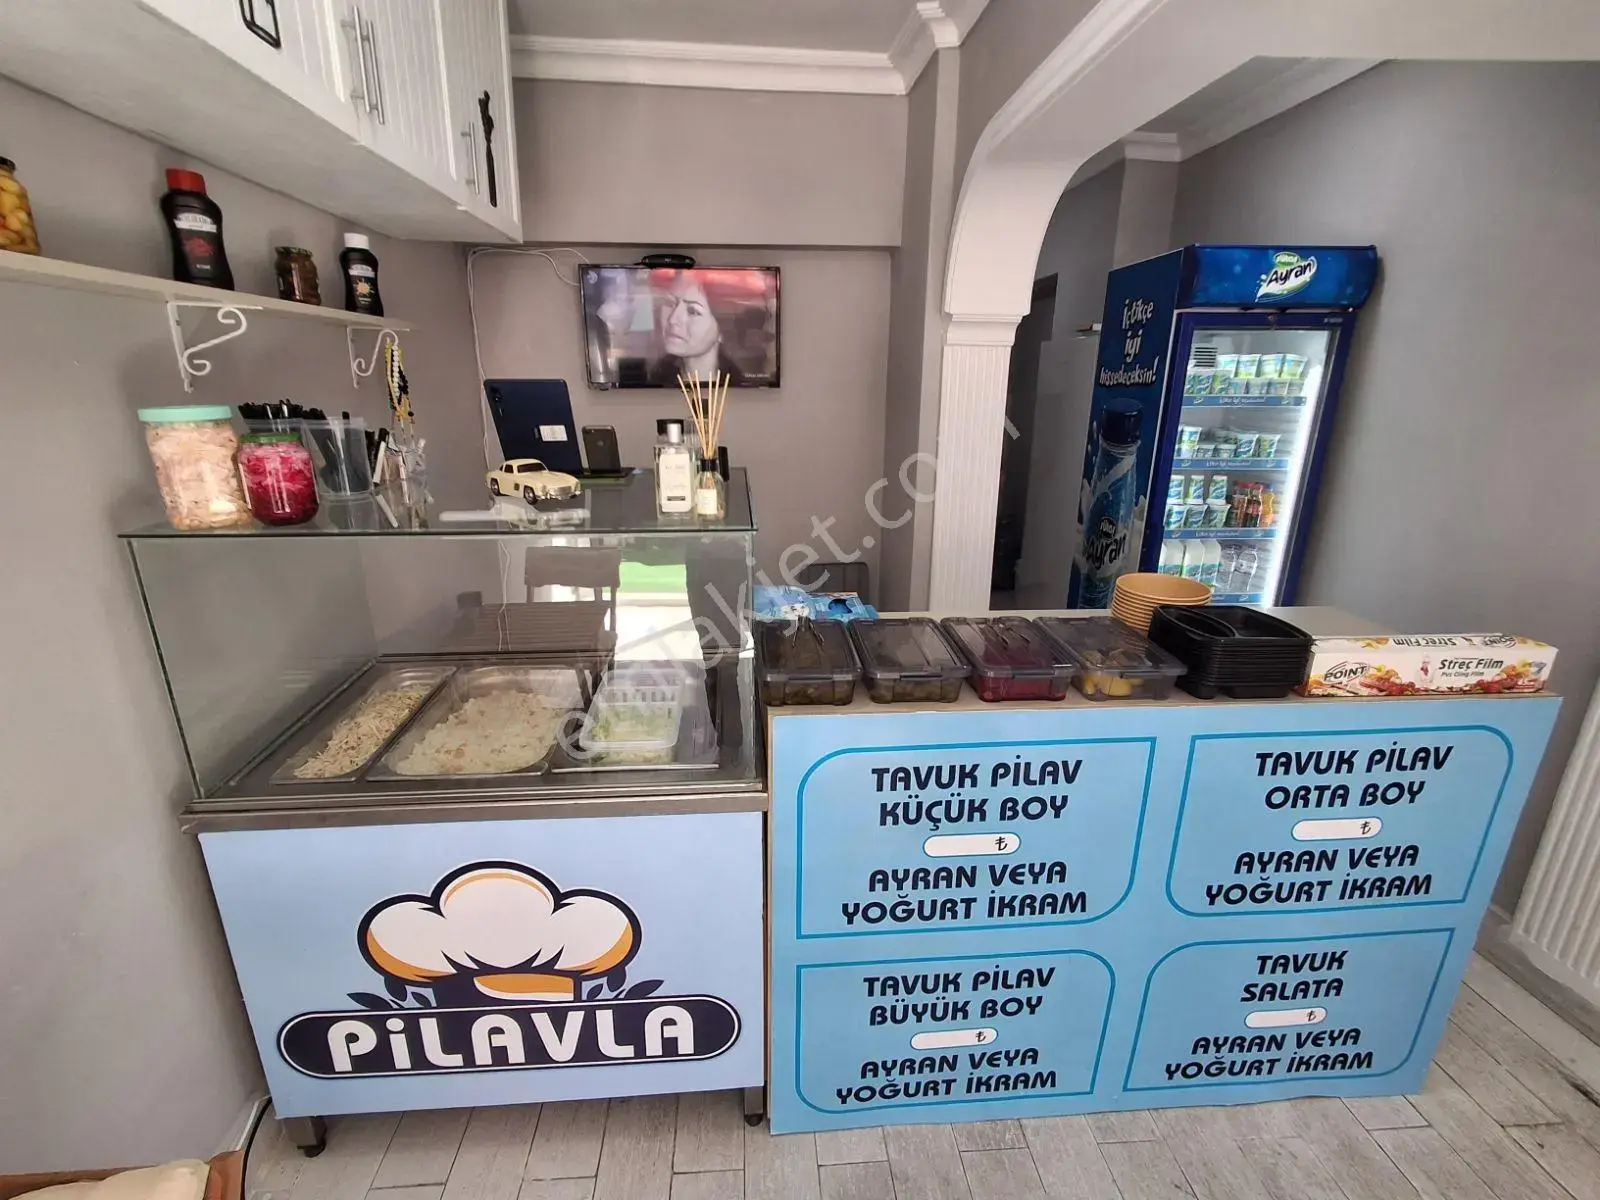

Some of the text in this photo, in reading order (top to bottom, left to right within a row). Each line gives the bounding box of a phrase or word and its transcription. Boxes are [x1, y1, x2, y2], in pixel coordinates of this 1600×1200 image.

[1266, 262, 1312, 287] Ayran
[1124, 329, 1142, 362] iyi
[1324, 666, 1367, 682] POINT
[1438, 659, 1504, 671] Streç Film
[872, 754, 1083, 792] TAVUK PİLAV
[1256, 741, 1454, 776] TAVUK PİLAV
[1265, 781, 1425, 809] ORTA BOY
[879, 792, 1068, 830] KÜÇÜK BOY
[1234, 845, 1420, 874] AYRAN VEYA
[869, 861, 1067, 892] AYRAN VEYA
[1206, 872, 1431, 906] YOĞURT İKRAM
[841, 889, 1087, 925] YOĞURT İKRAM
[1256, 951, 1348, 975] TAVUK
[863, 964, 1056, 997] TAVUK PİLAV
[1240, 978, 1343, 1002] SALATA
[870, 996, 1043, 1026] BÜYÜK BOY
[1191, 1028, 1361, 1055] AYRAN VEYA
[861, 1048, 1038, 1079] AYRAN VEYA
[1165, 1052, 1373, 1080] YOĞURT İKRAM
[836, 1071, 1056, 1104] YOĞURT İKRAM
